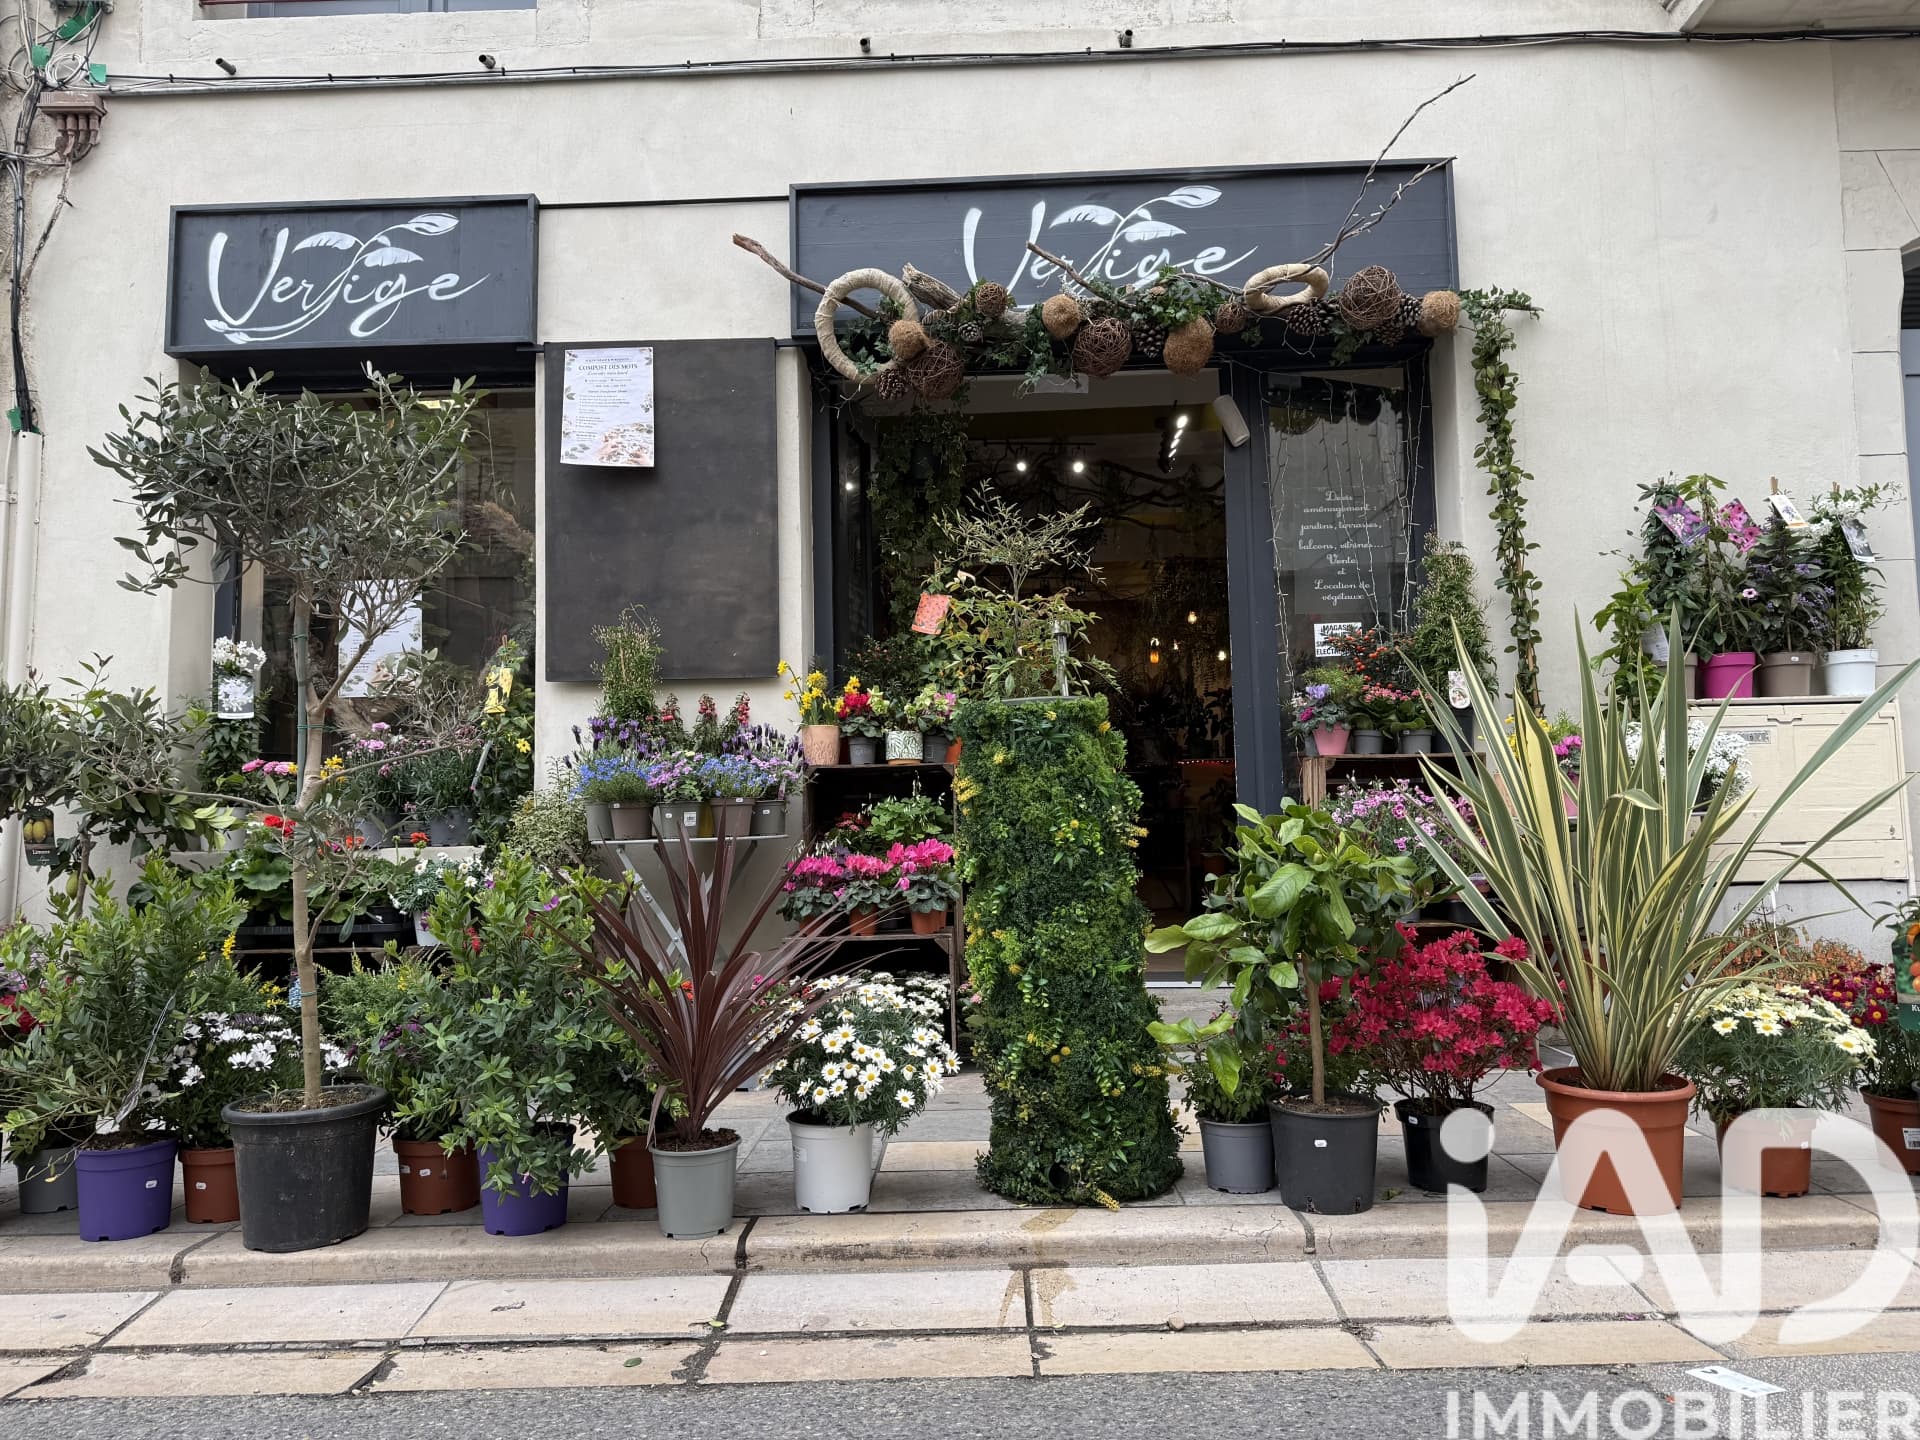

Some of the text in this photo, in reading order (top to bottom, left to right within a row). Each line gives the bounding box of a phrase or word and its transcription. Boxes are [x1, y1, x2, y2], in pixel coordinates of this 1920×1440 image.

[203, 213, 491, 344] Vertige
[1300, 521, 1337, 536] jardins,
[1298, 538, 1337, 550] balcons,
[1326, 554, 1357, 565] Vente
[1337, 567, 1347, 575] et
[1314, 578, 1371, 590] Location de
[1322, 592, 1365, 607] végétaux
